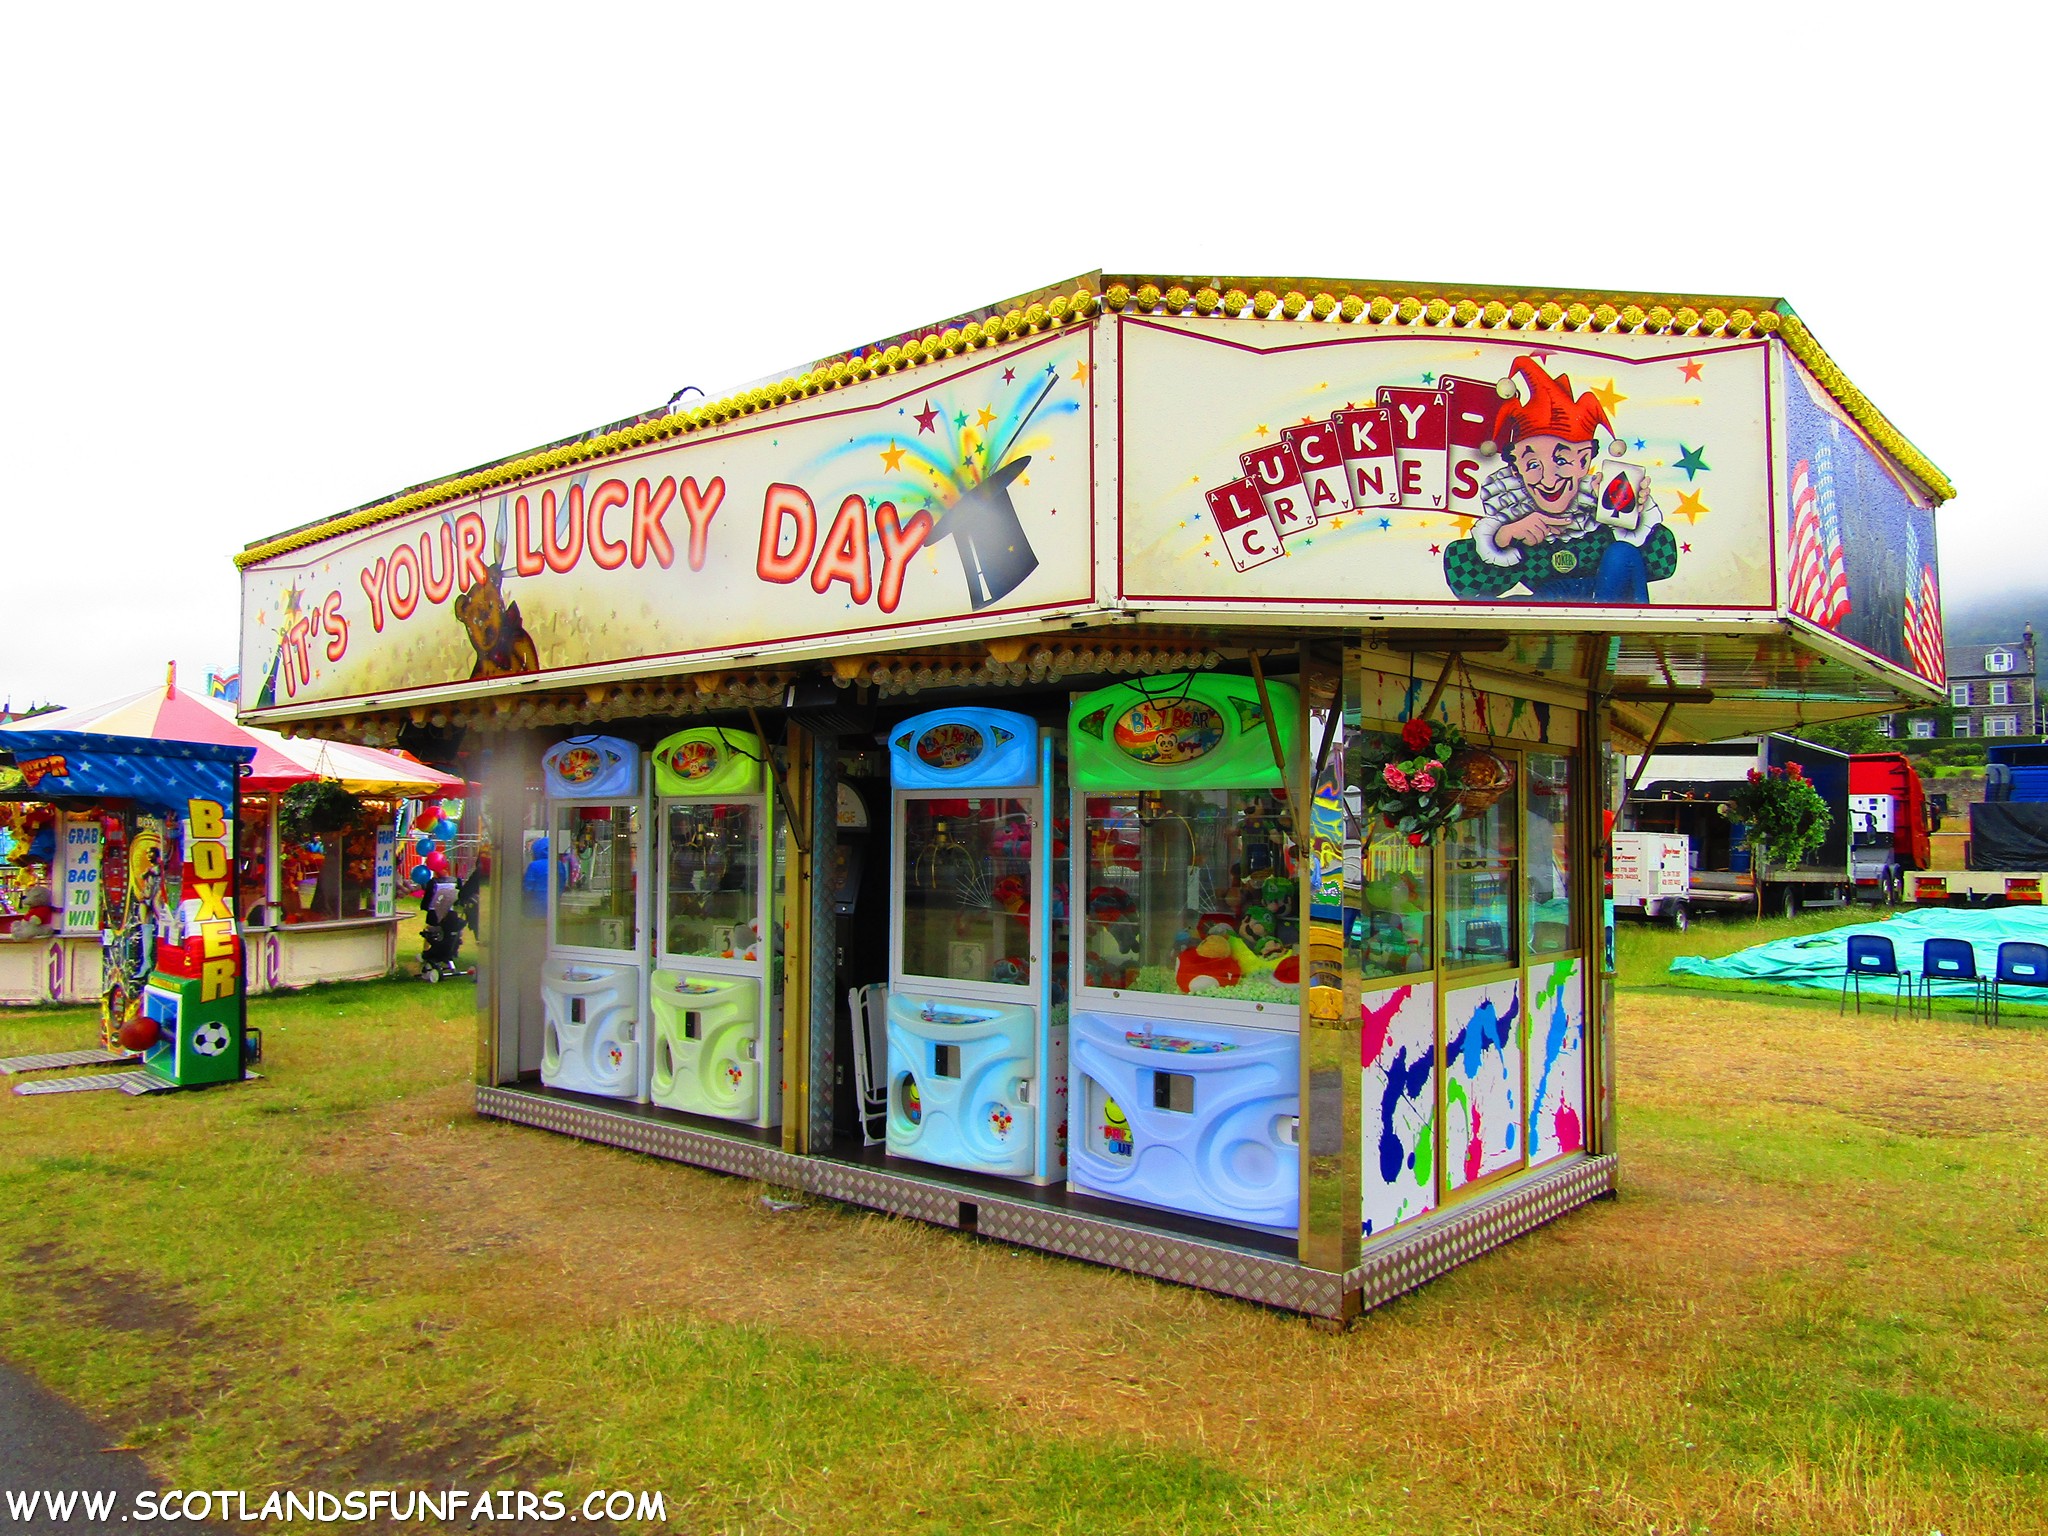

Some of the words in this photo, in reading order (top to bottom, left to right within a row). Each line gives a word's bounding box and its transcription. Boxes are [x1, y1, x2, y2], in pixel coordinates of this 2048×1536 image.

[1445, 380, 1455, 394] 2
[1382, 391, 1392, 403] A
[1433, 394, 1444, 406] A
[1336, 414, 1344, 425] 2
[1379, 411, 1387, 421] 2
[1325, 423, 1333, 434] A
[1286, 432, 1294, 442] A
[1282, 444, 1290, 454] 2
[1243, 456, 1252, 466] 2
[1245, 479, 1253, 489] A
[1211, 493, 1219, 503] A
[1242, 460, 1480, 555] CRANES
[280, 590, 348, 698] IT'S
[361, 512, 487, 633] YOUR
[516, 475, 726, 577] LUCKY
[756, 482, 934, 614] DAY
[68, 828, 99, 845] GRAB
[78, 851, 89, 864] A
[382, 850, 389, 861] A
[67, 869, 97, 883] BAG
[74, 889, 90, 905] TO
[188, 799, 236, 1003] BOXER
[68, 911, 95, 926] WIN
[1104, 1125, 1134, 1143] PRIZ
[1109, 1139, 1134, 1157] OUT
